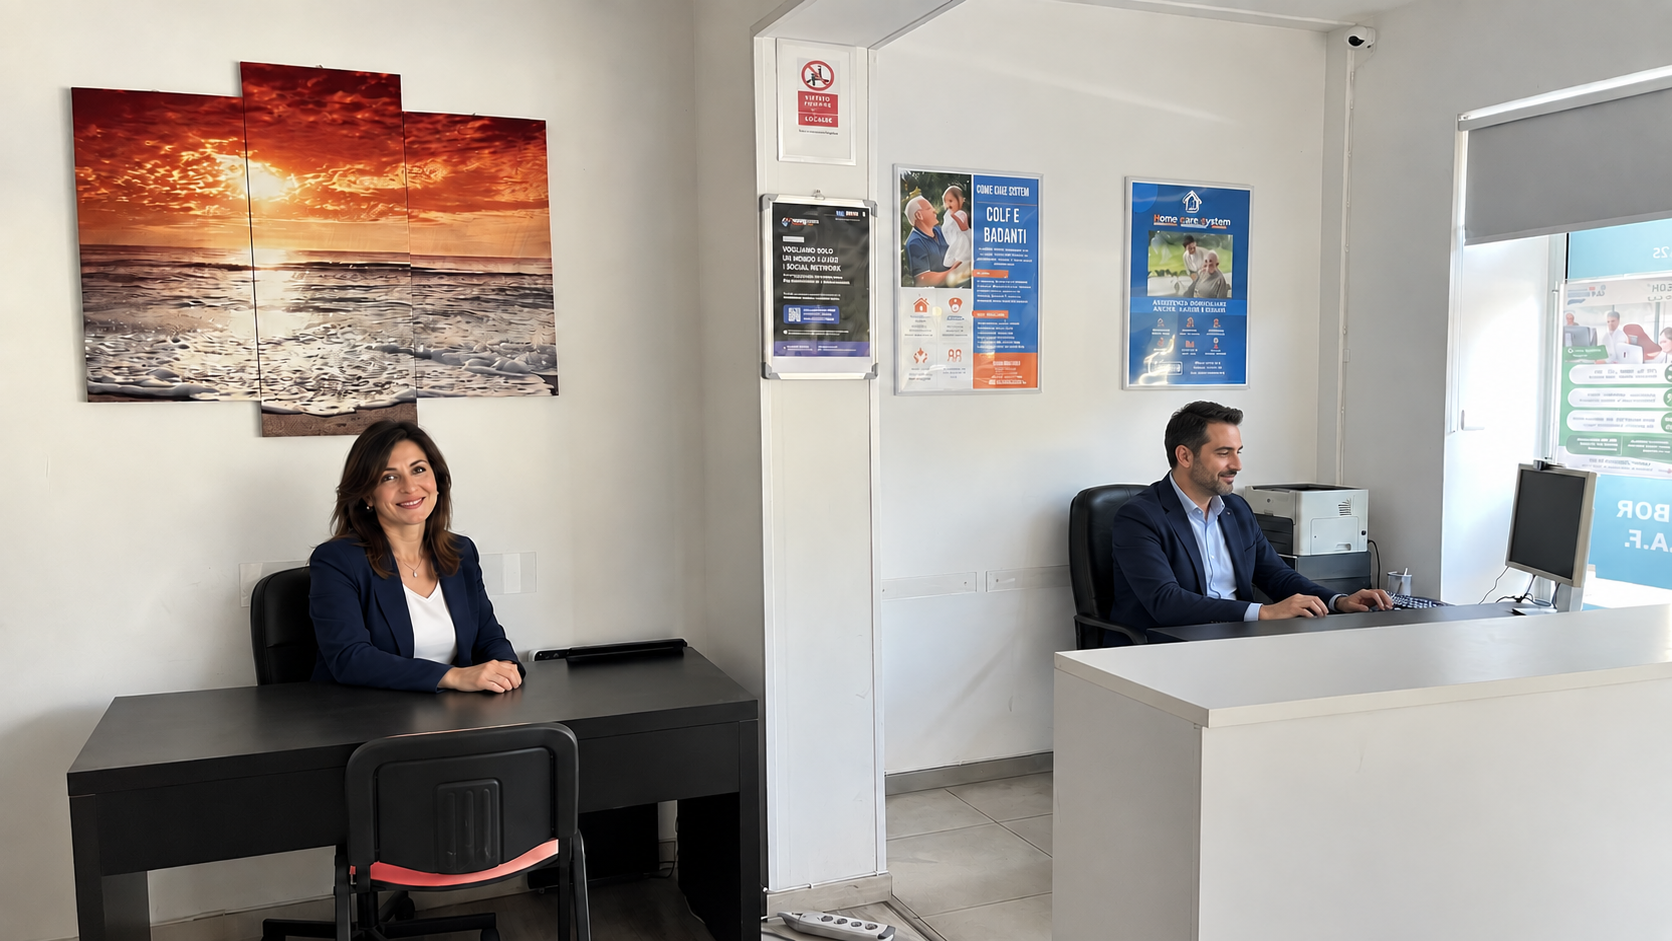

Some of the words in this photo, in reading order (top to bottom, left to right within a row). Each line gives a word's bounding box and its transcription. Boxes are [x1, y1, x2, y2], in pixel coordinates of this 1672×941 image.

[986, 206, 1011, 223] COLF
[1013, 208, 1020, 223] E
[1153, 214, 1178, 223] Home
[983, 227, 1027, 244] BADANTI
[786, 262, 810, 271] SOCIAL
